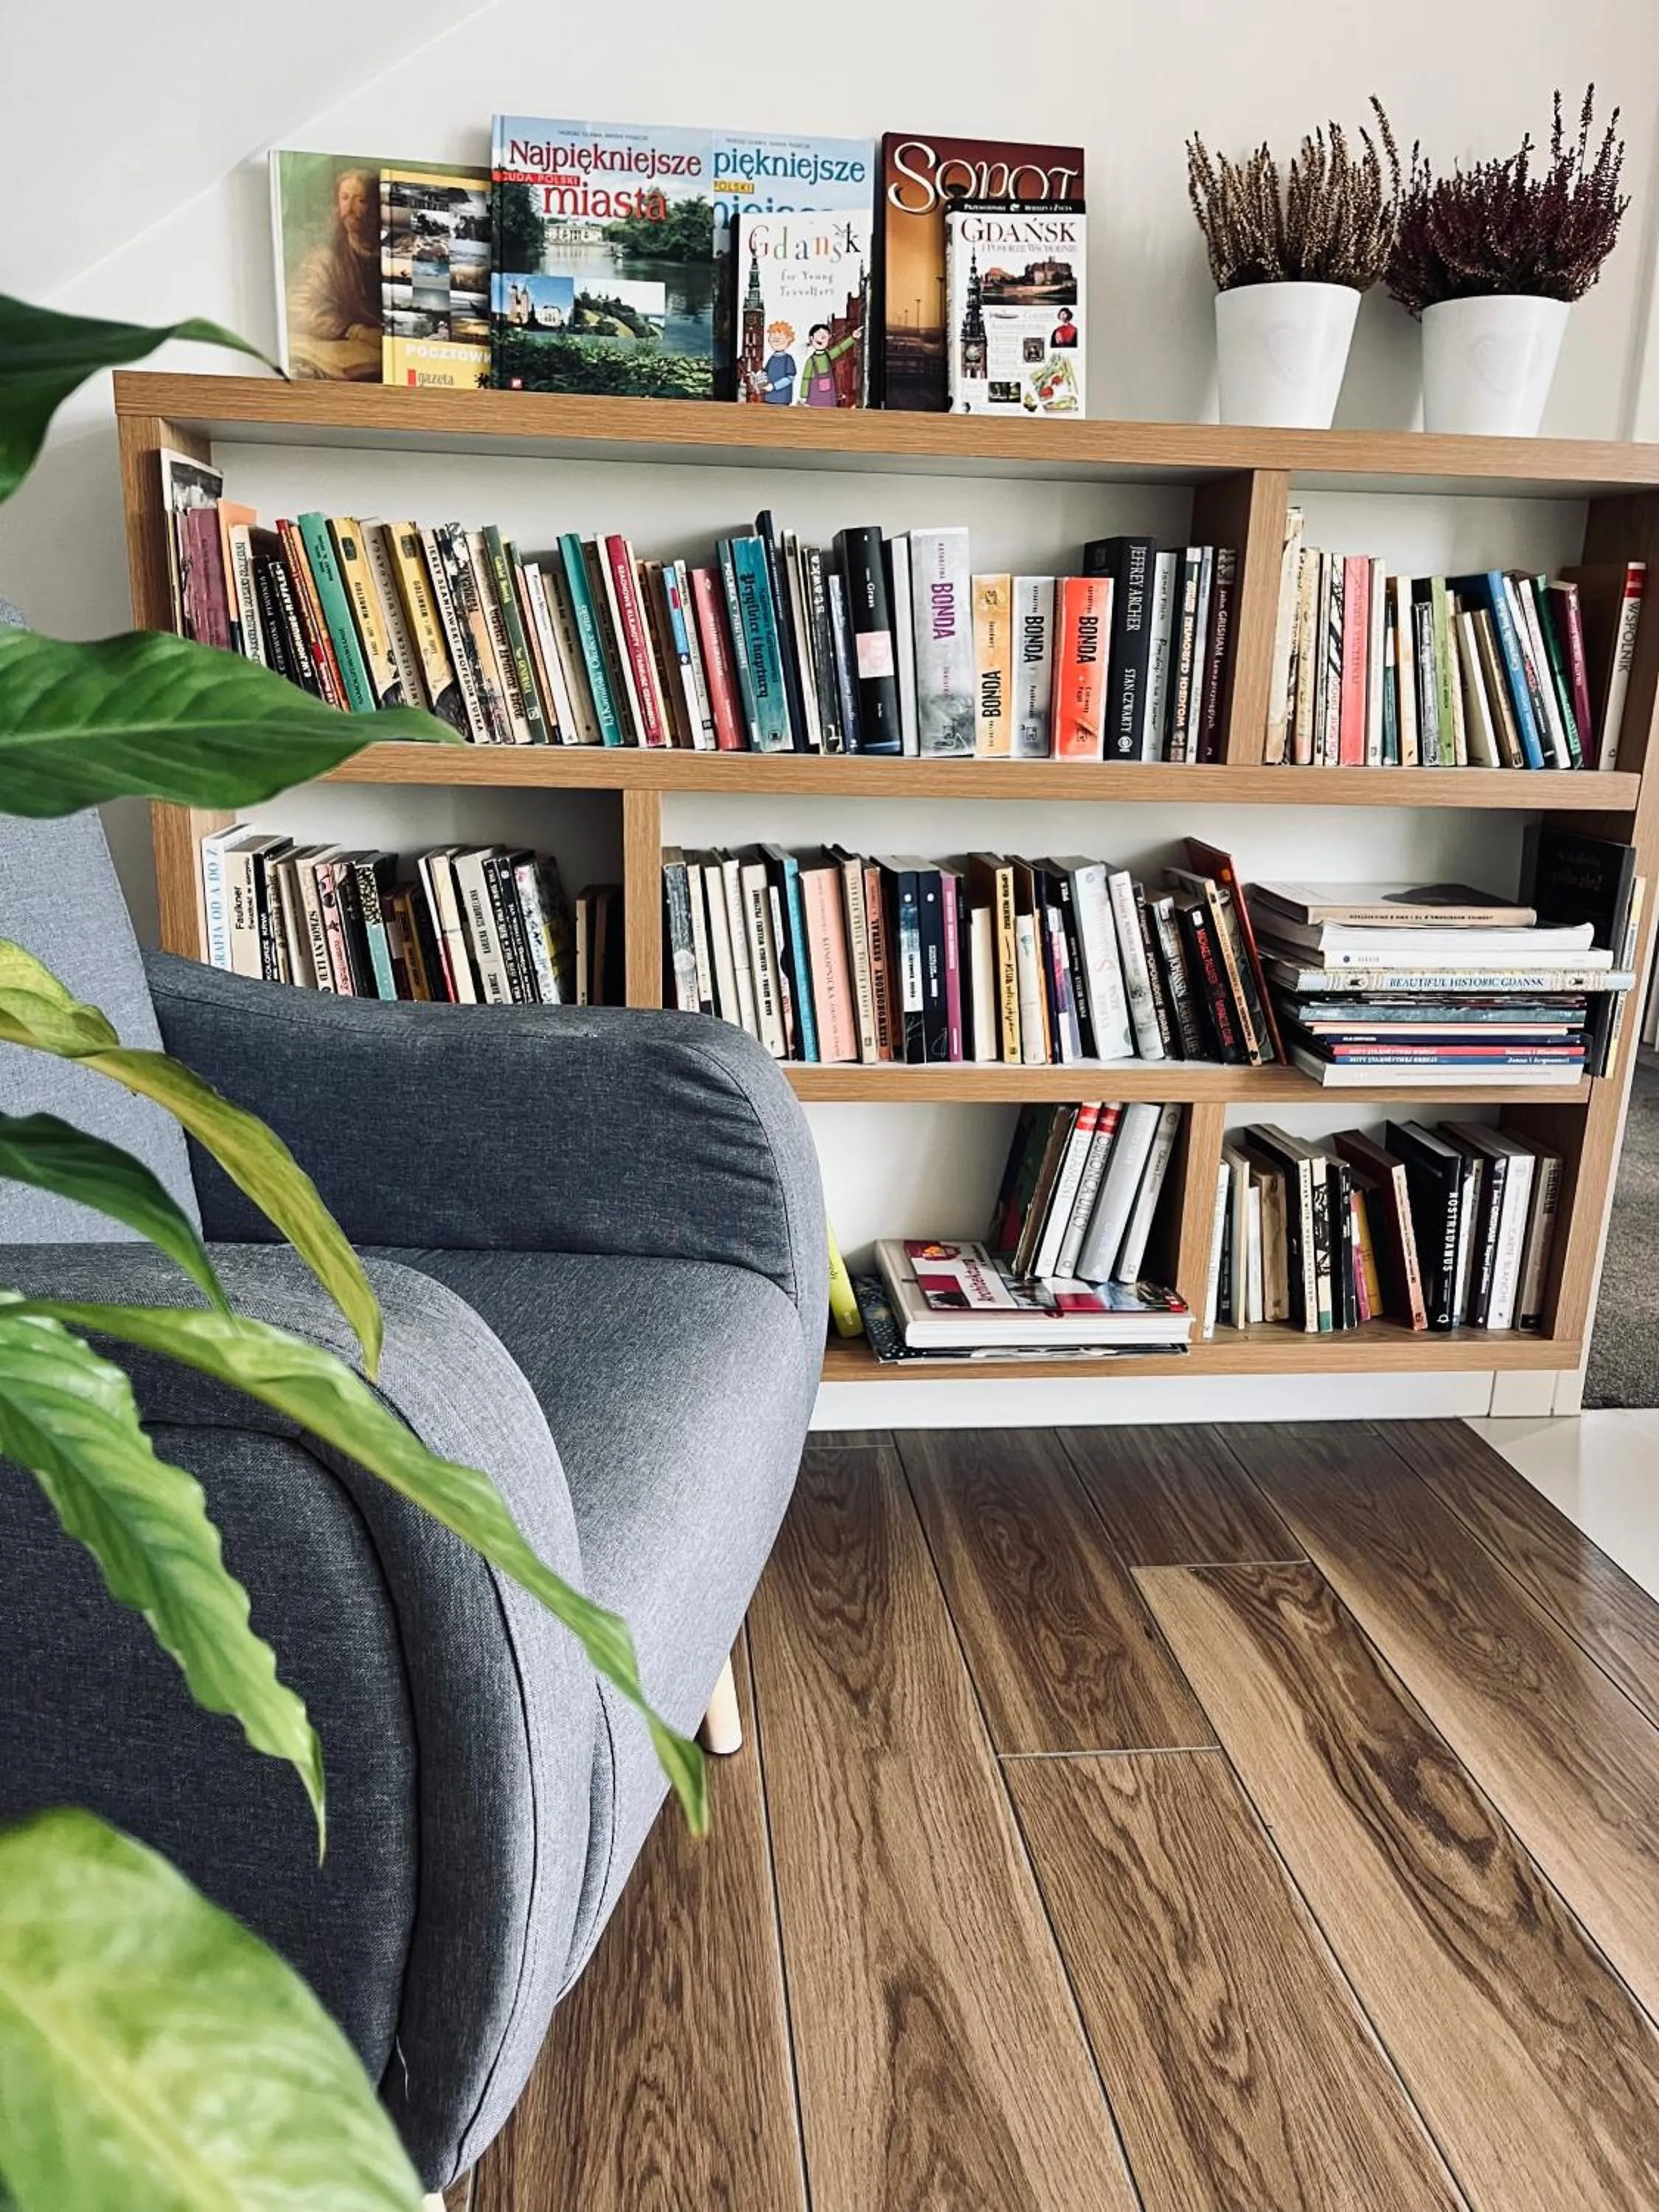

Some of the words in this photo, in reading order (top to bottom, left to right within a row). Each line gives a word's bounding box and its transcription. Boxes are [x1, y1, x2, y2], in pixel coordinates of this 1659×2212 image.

[509, 140, 701, 178] Najpiękniejsze
[538, 174, 578, 184] POLSKI
[888, 141, 1081, 214] SOPOT
[543, 182, 667, 220] miasta
[961, 218, 1077, 243] GDAŃSK
[781, 268, 796, 281] for
[802, 271, 834, 283] Young
[418, 373, 455, 386] gazeta
[723, 563, 737, 602] POLSKA
[1129, 546, 1147, 589] JEFFREY
[260, 575, 275, 616] PIWONIA
[276, 568, 293, 611] RAFFLES
[617, 564, 633, 608] SZACHOWE
[626, 609, 640, 647] KLEJNOTY
[866, 582, 875, 608] Grass
[1126, 588, 1144, 632] ARCHER
[1219, 591, 1227, 609] John
[931, 582, 956, 640] BONDA
[271, 620, 285, 671] CZERWONA
[428, 545, 442, 574] JERZY
[437, 579, 459, 644] SZANIAWSKI
[455, 648, 473, 697] PROFESOR
[470, 700, 484, 732] TUTKA
[1023, 616, 1045, 663] BONDA
[1076, 616, 1099, 664] BONDA
[1180, 616, 1194, 674] CEJROWSKI
[1214, 611, 1228, 655] GRISHAM
[981, 670, 1001, 718] BONDA
[1124, 669, 1137, 690] STAN
[1120, 692, 1135, 733] CZWARTY
[1176, 677, 1189, 728] WOJCIECH
[206, 849, 218, 857] Z
[207, 862, 220, 881] DO
[211, 902, 223, 919] OD
[234, 886, 245, 930] Faulkner
[260, 913, 269, 936] KRWI
[1196, 928, 1211, 959] MICHAEL
[822, 937, 836, 1000] KONOPNICKA
[1004, 963, 1014, 984] KLUB
[1203, 958, 1219, 986] PALMER
[1389, 978, 1447, 988] BEAUTIFUL
[1450, 978, 1499, 988] HISTORIC
[1062, 1133, 1091, 1200] TESTAMENT
[1073, 1198, 1093, 1232] ULICY
[1443, 1192, 1459, 1272] NOSTRADAMUS
[1505, 1227, 1517, 1256] CARTE
[1499, 1260, 1513, 1304] BLANCHE
